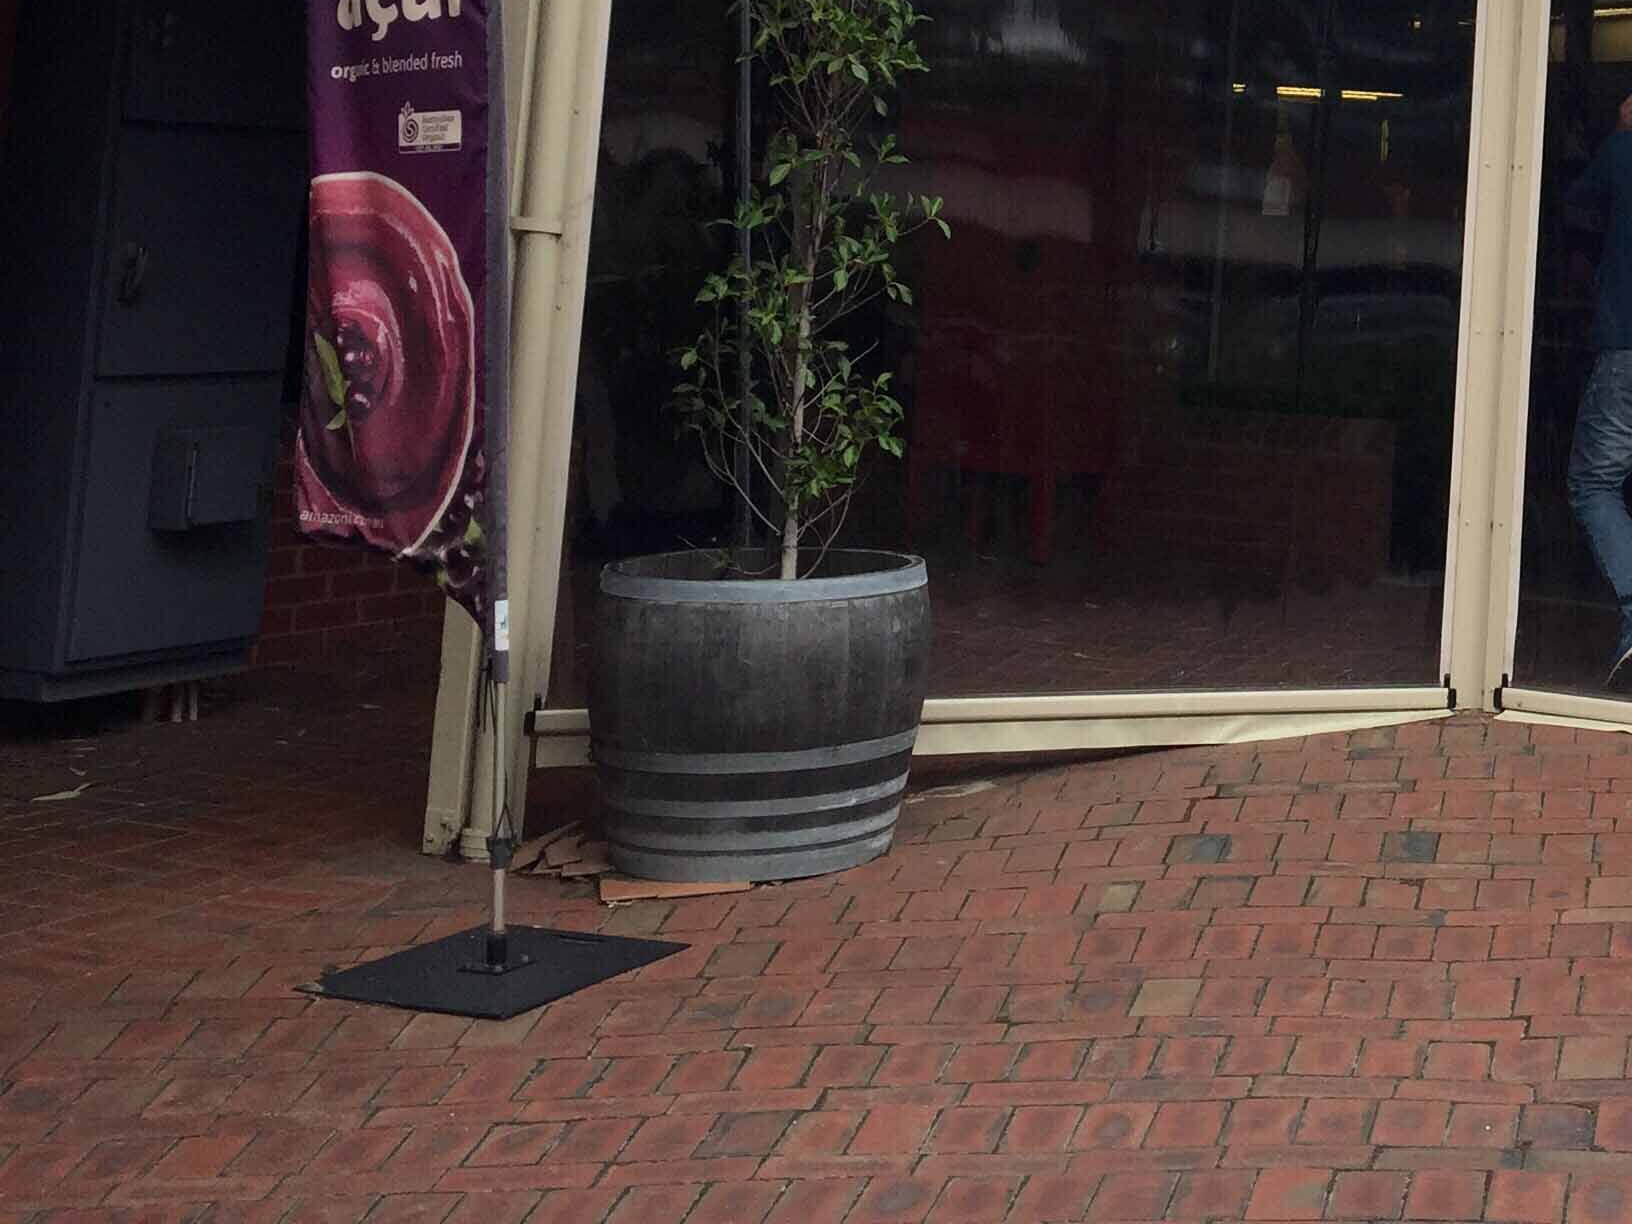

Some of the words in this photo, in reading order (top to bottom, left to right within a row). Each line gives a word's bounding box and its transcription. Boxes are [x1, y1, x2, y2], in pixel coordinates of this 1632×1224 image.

[371, 58, 380, 75] &
[382, 53, 428, 74] blended
[430, 50, 463, 69] fresh
